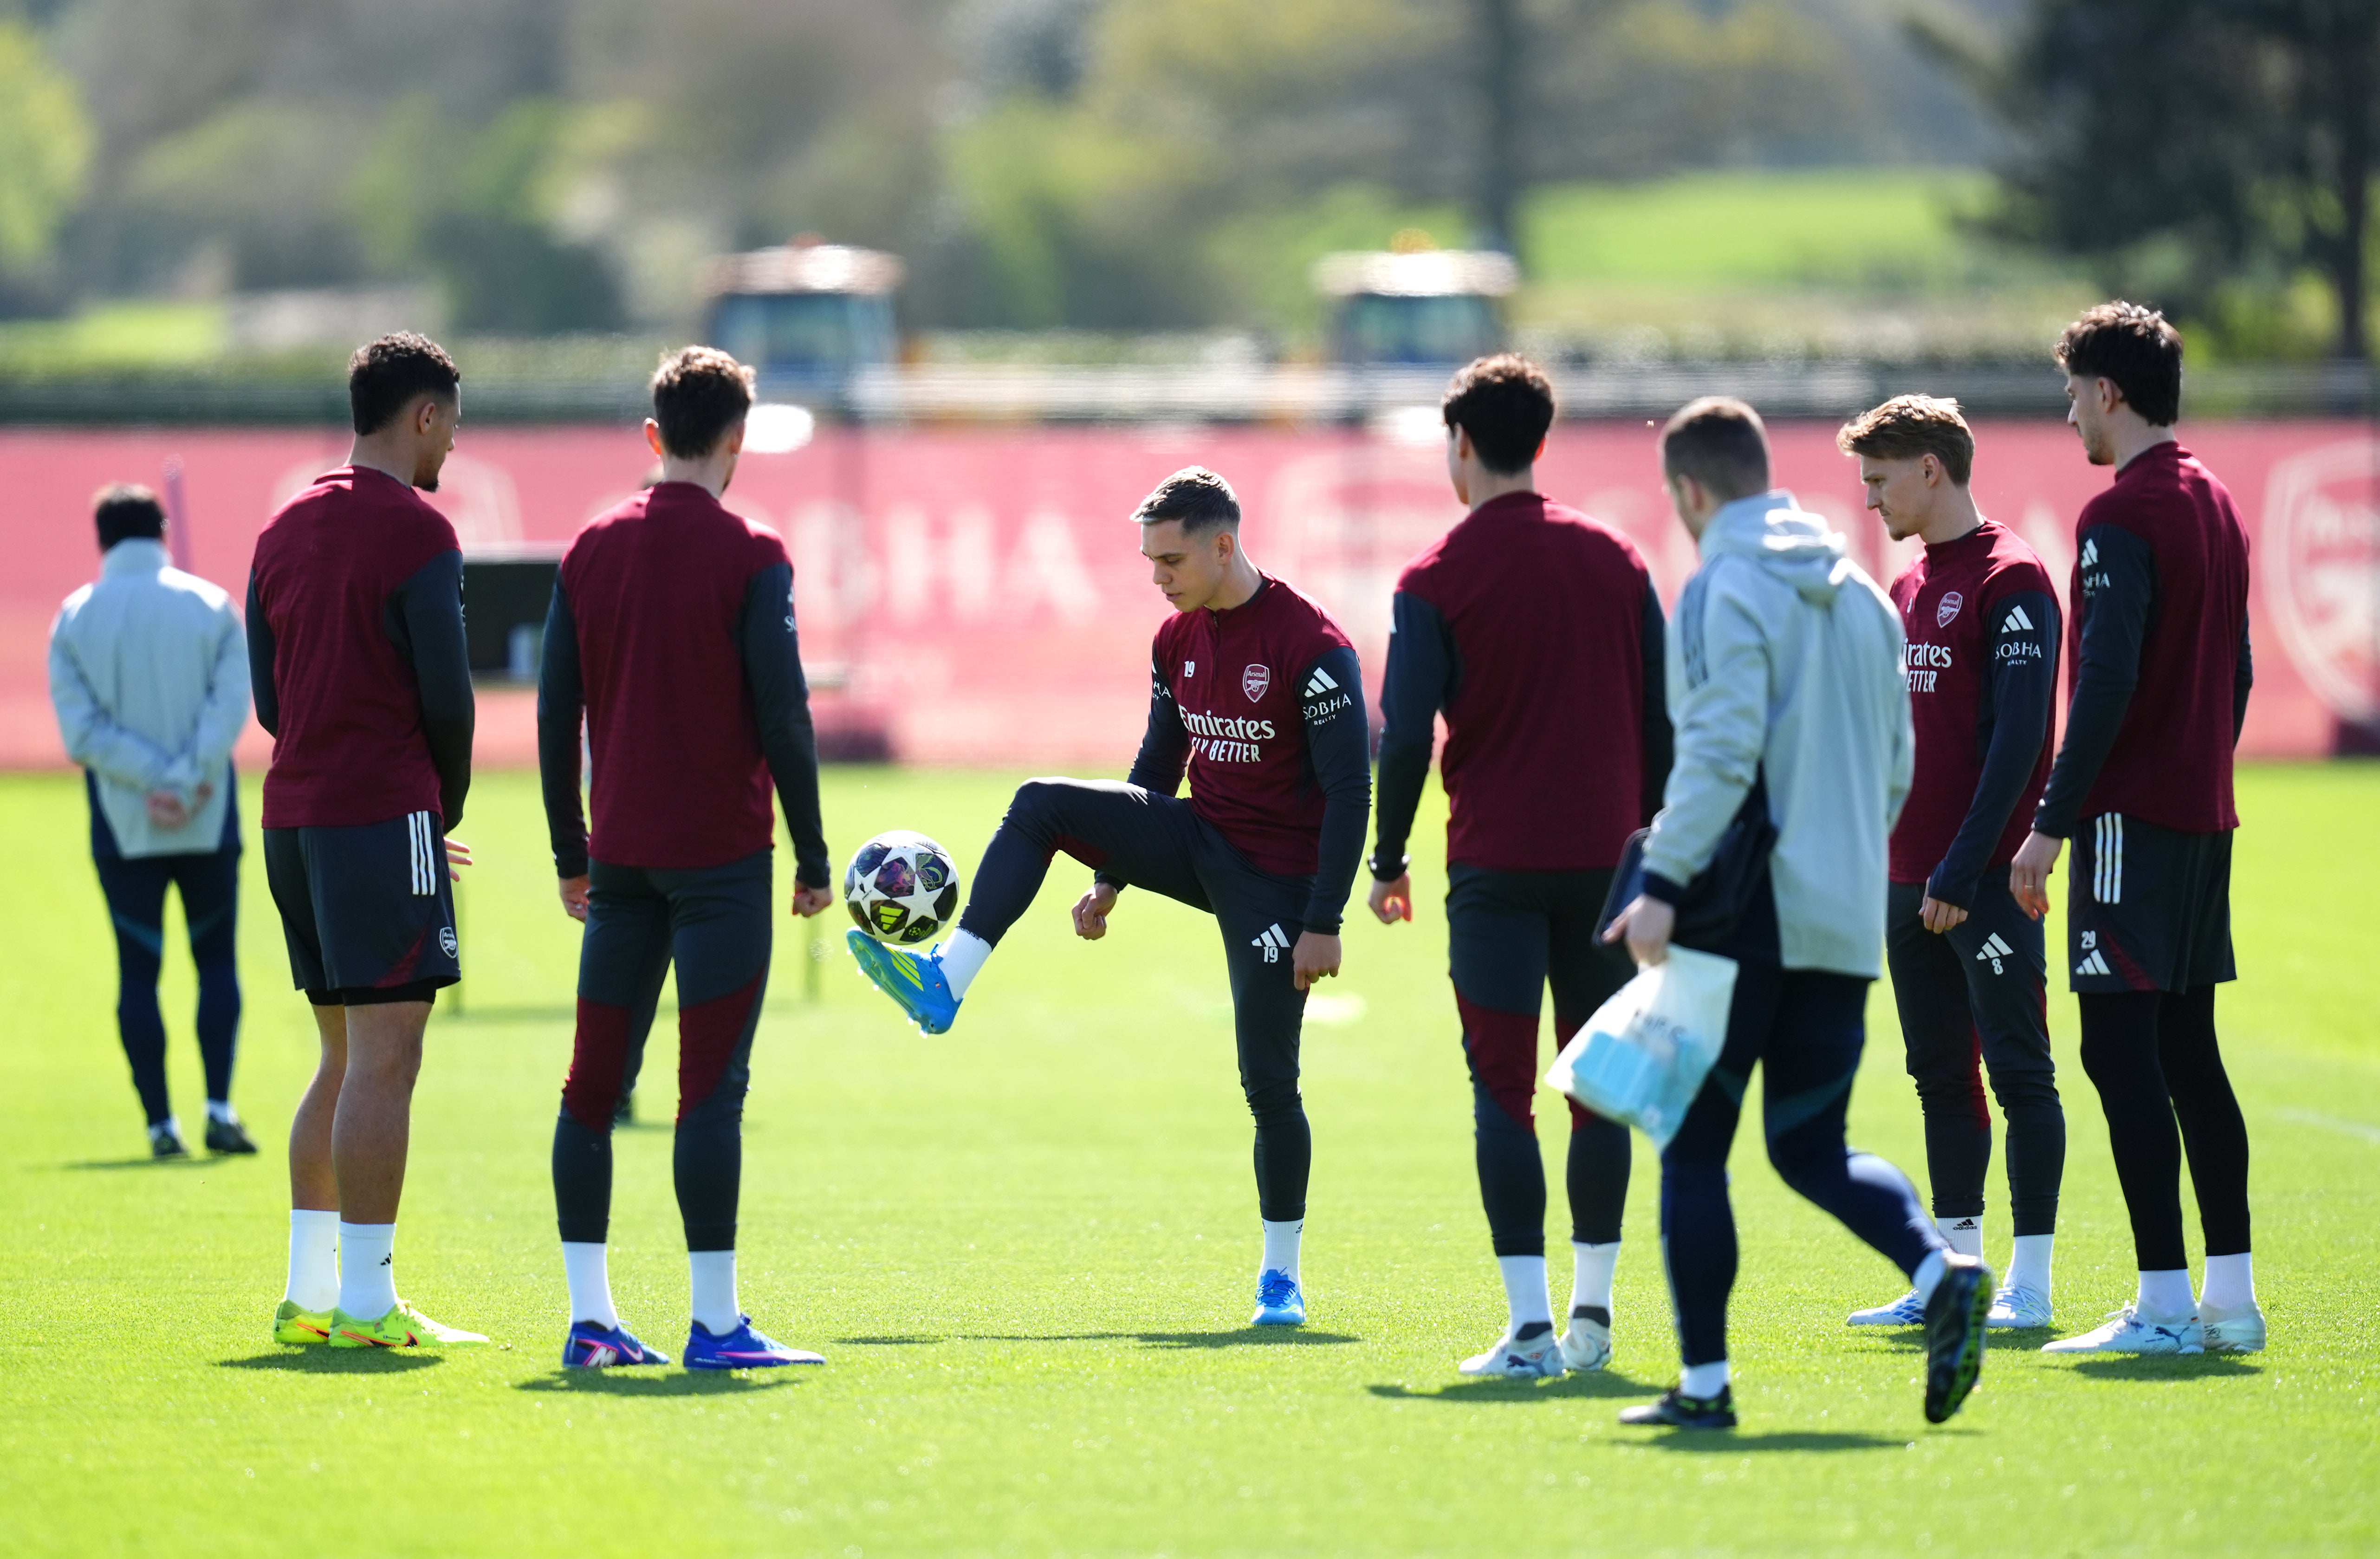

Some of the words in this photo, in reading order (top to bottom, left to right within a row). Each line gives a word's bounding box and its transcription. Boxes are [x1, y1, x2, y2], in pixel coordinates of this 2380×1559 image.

[1903, 637, 1952, 668] irates
[1184, 661, 1195, 678] 19
[1905, 670, 1938, 693] ETTER
[1303, 693, 1352, 720] SOBHA
[1179, 704, 1276, 741] Emirates
[1314, 714, 1336, 726] REALTY
[1209, 740, 1262, 763] BETTER
[2081, 930, 2096, 949] 29
[1263, 946, 1278, 963] 19
[1991, 957, 2004, 975] 8
